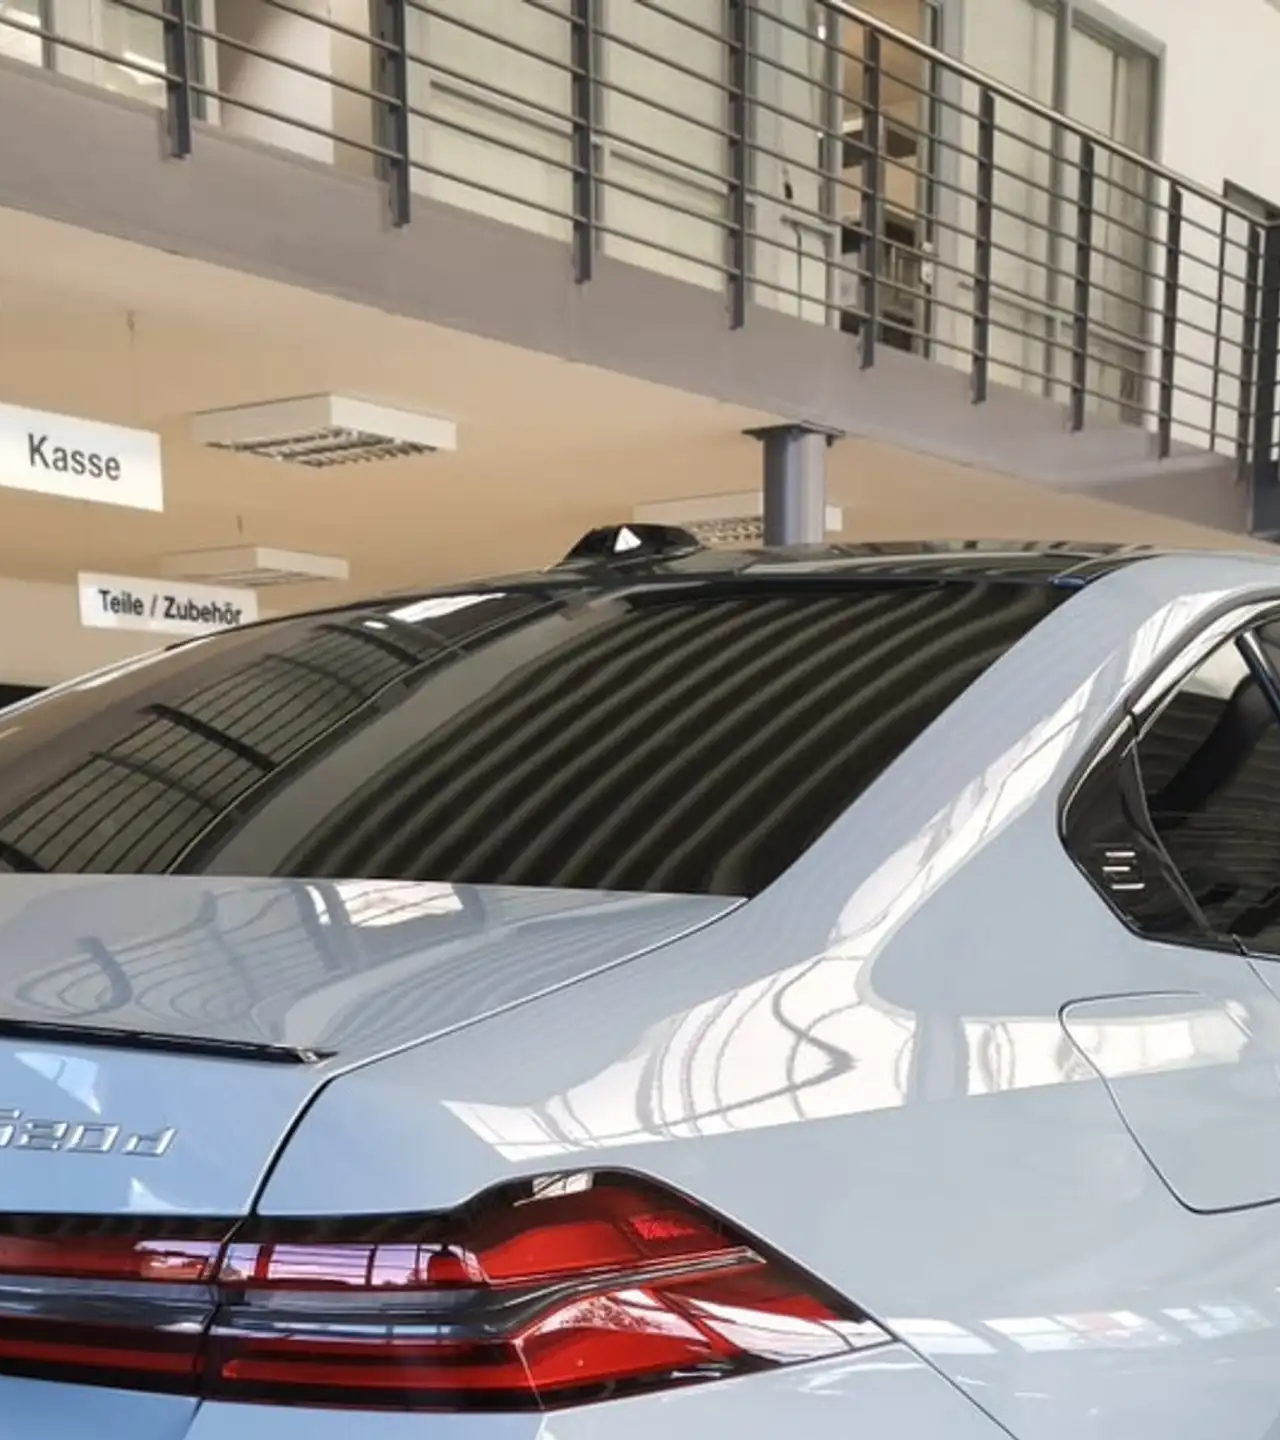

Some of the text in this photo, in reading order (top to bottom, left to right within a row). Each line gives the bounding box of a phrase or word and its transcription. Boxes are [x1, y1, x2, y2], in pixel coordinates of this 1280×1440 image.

[27, 433, 122, 482] Kasse
[98, 589, 243, 625] Teile / Zubehör
